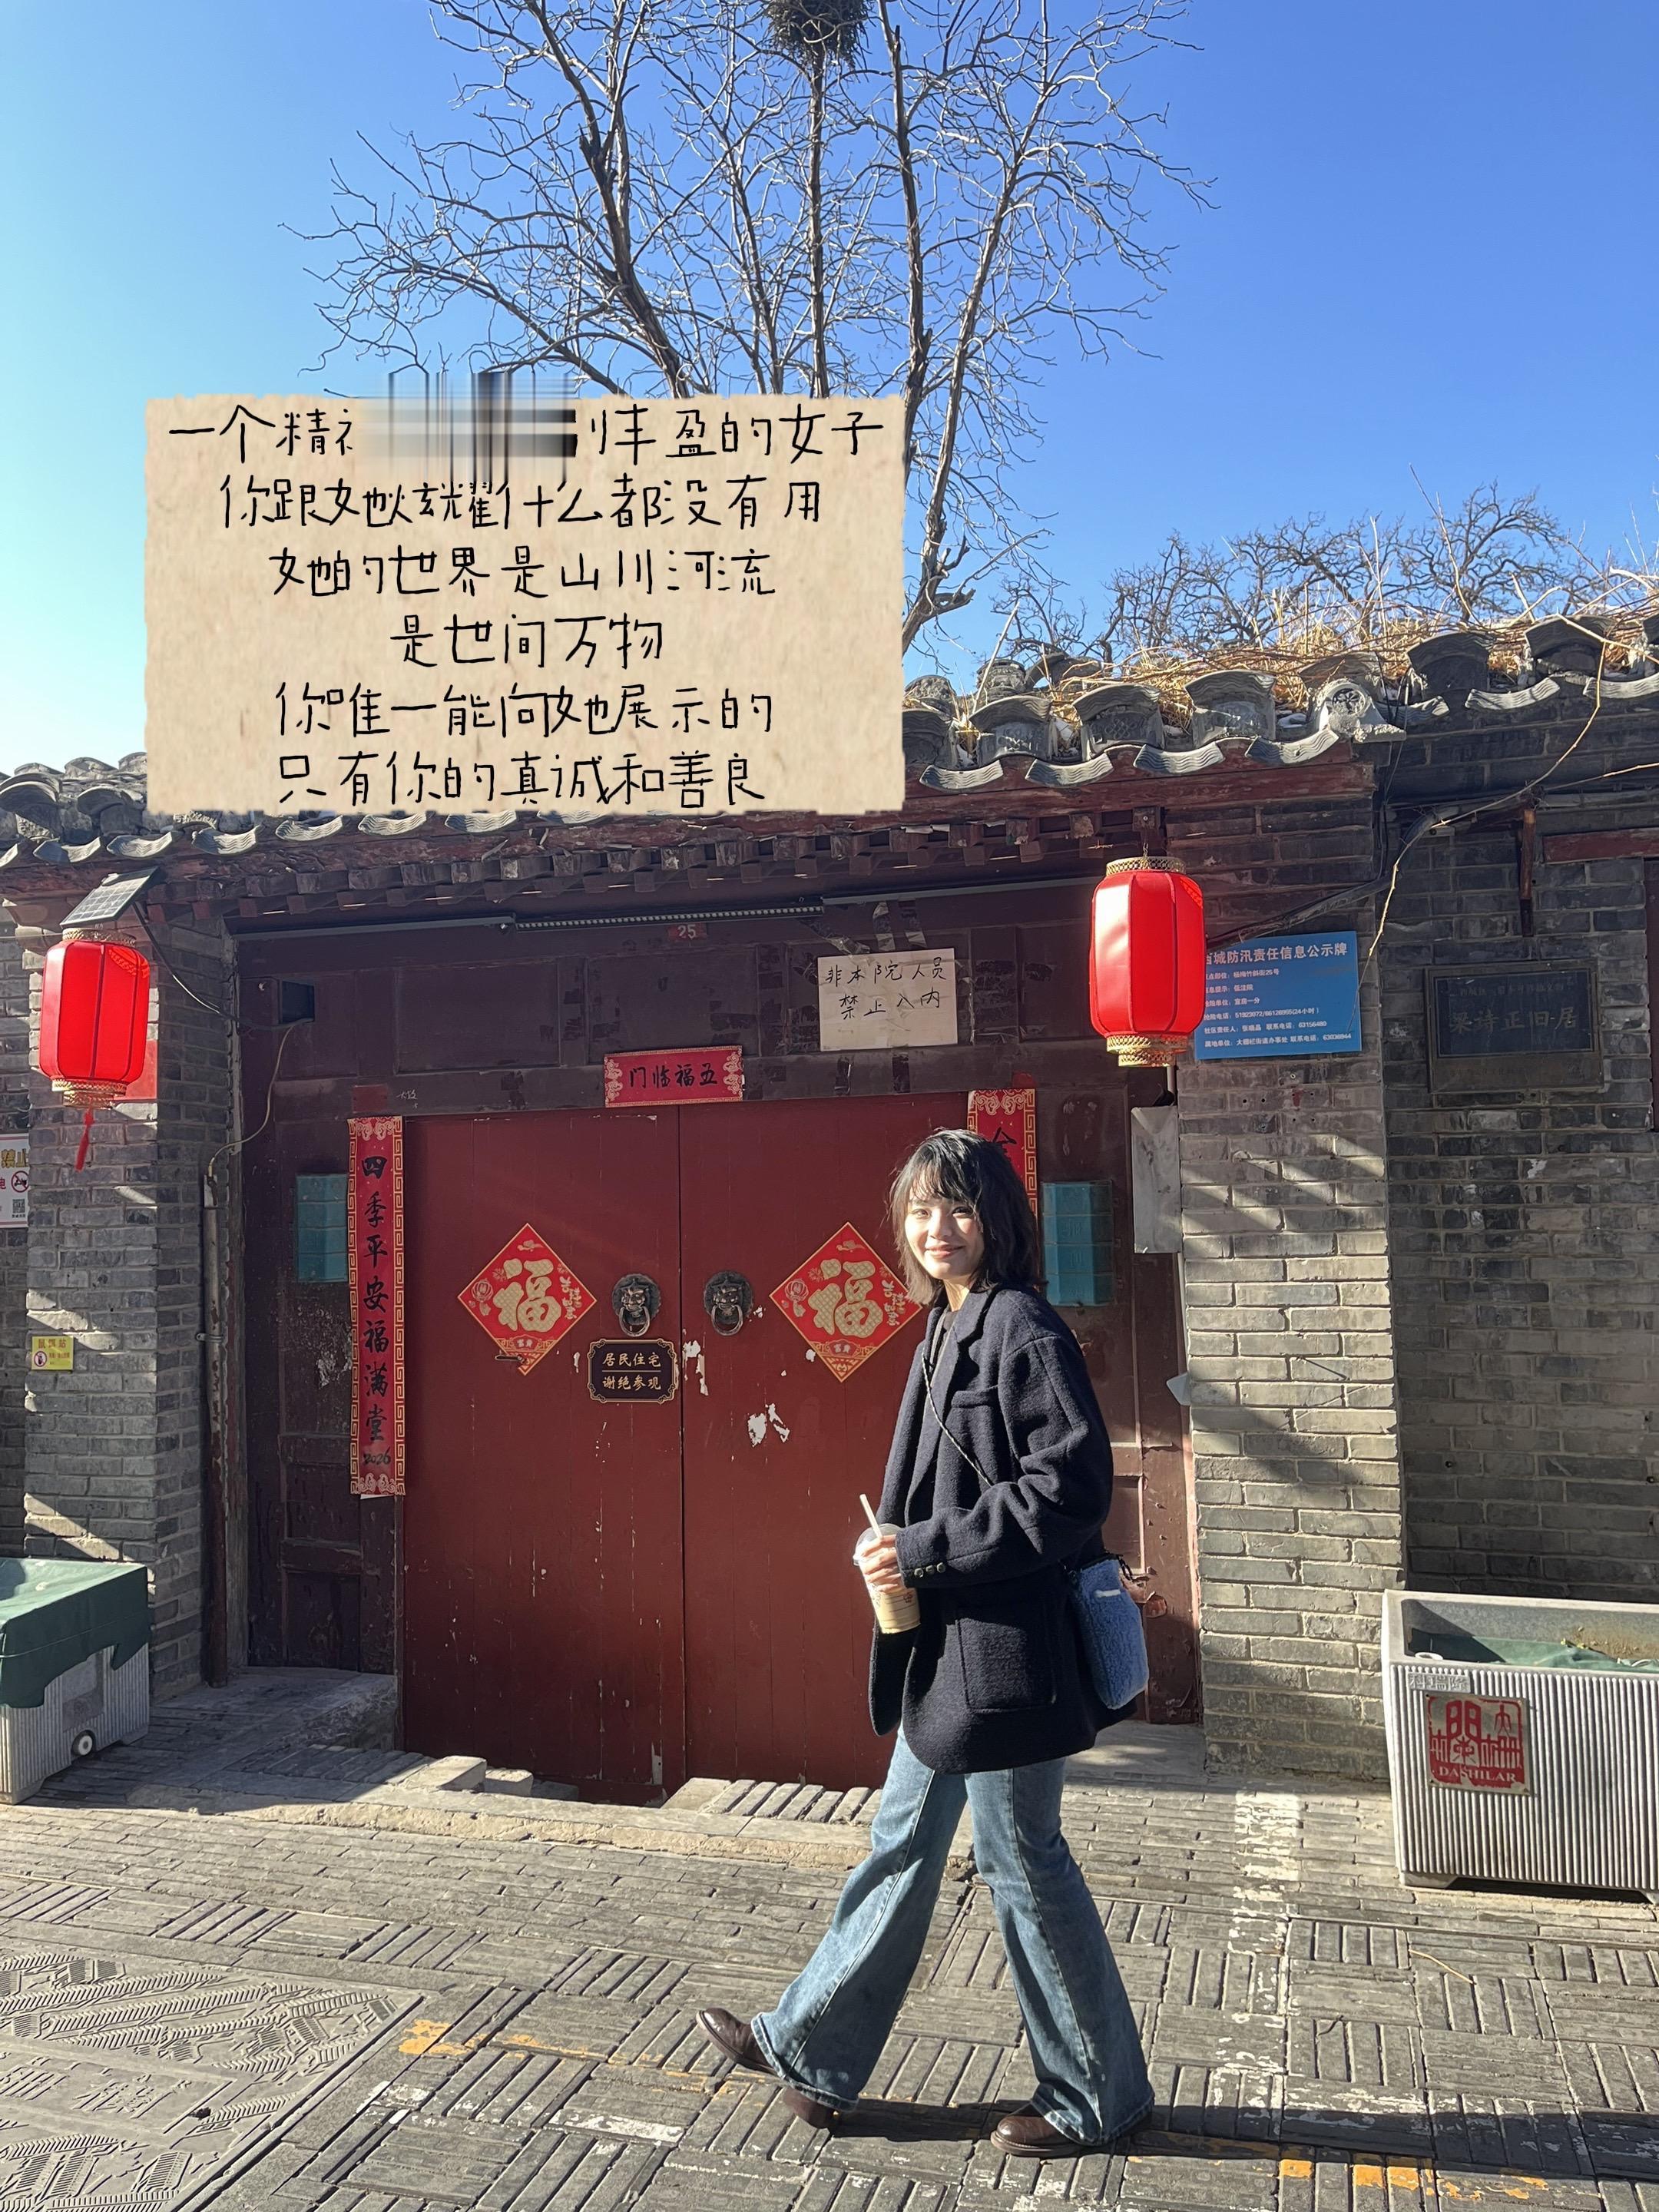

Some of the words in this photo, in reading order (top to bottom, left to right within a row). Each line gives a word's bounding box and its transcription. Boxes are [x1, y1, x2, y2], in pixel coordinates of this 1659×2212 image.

[677, 924, 697, 939] 25
[826, 957, 946, 988] 非本院人员
[839, 986, 940, 1021] 禁止入内
[361, 1155, 390, 1442] 四季平安福满堂
[492, 1258, 561, 1333] 福
[808, 1259, 883, 1338] 福
[602, 1352, 661, 1367] 居民住宅
[602, 1375, 661, 1391] 谢绝参观
[363, 1446, 391, 1465] 2026
[1439, 1766, 1517, 1782] DASHILAR
